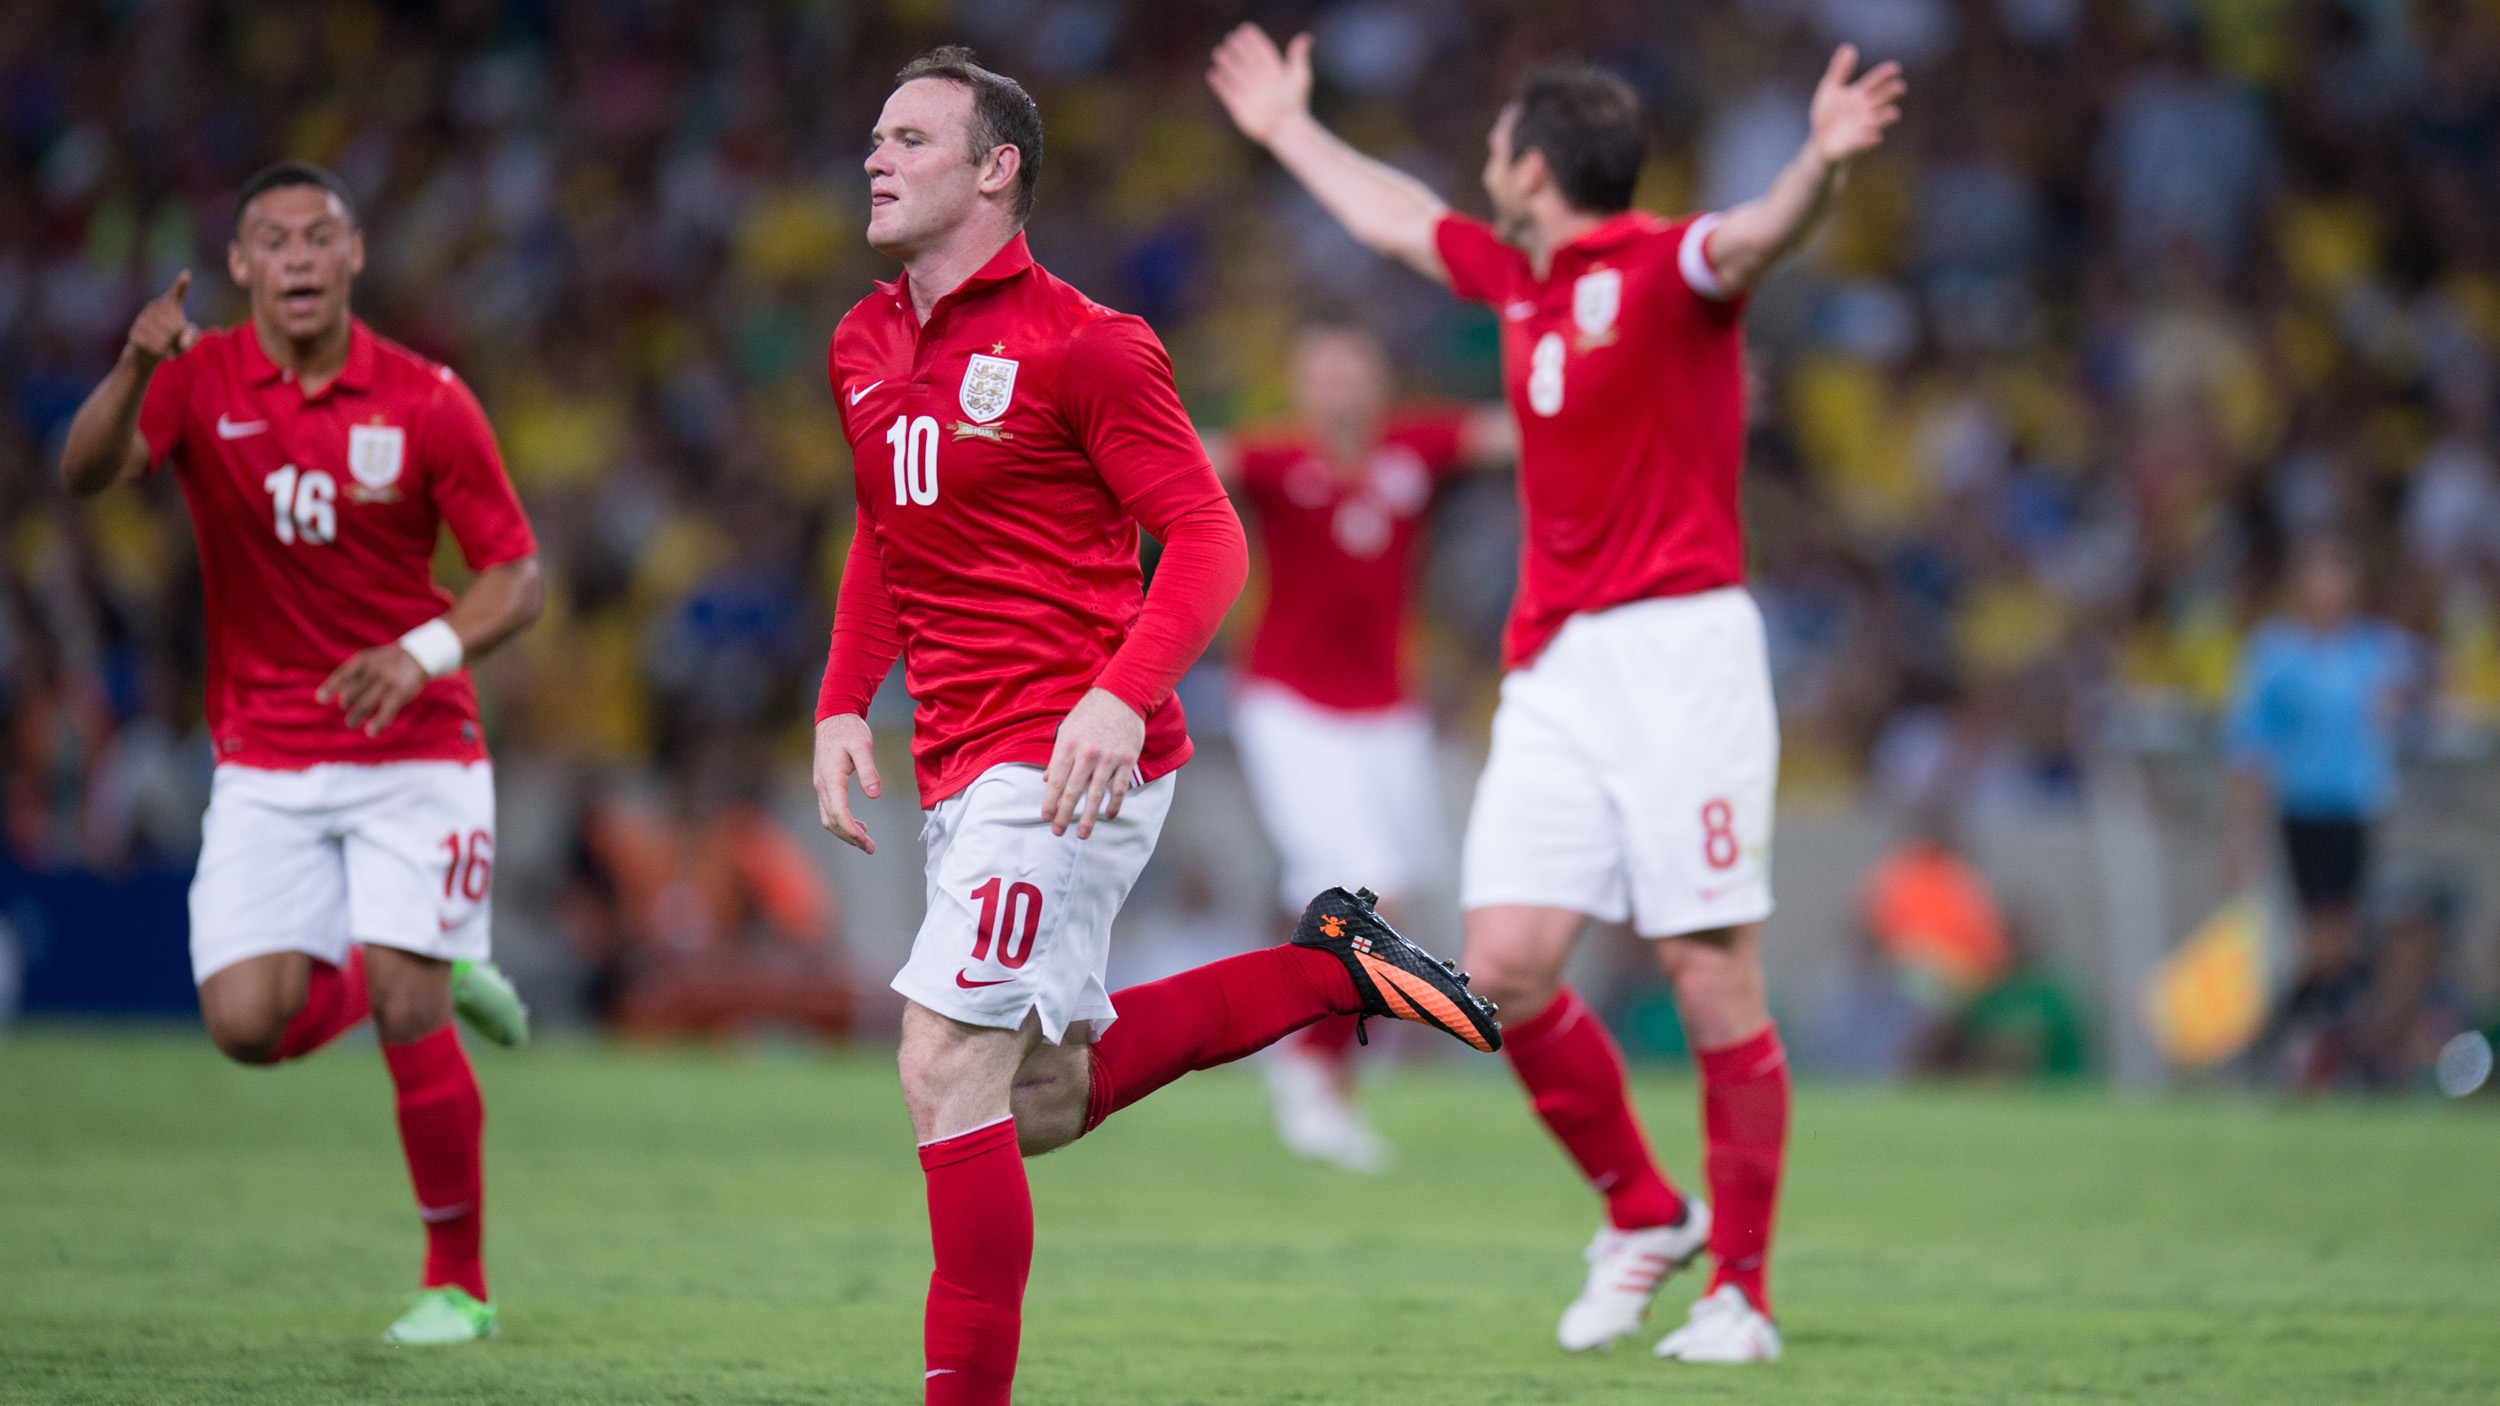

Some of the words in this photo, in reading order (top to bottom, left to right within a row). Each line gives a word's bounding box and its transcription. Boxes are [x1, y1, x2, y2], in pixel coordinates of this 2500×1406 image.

[1527, 331, 1567, 418] 8
[886, 415, 940, 506] 10
[263, 463, 338, 546] 16
[438, 830, 492, 904] 16
[1701, 798, 1739, 871] 8
[970, 877, 1043, 969] 10
